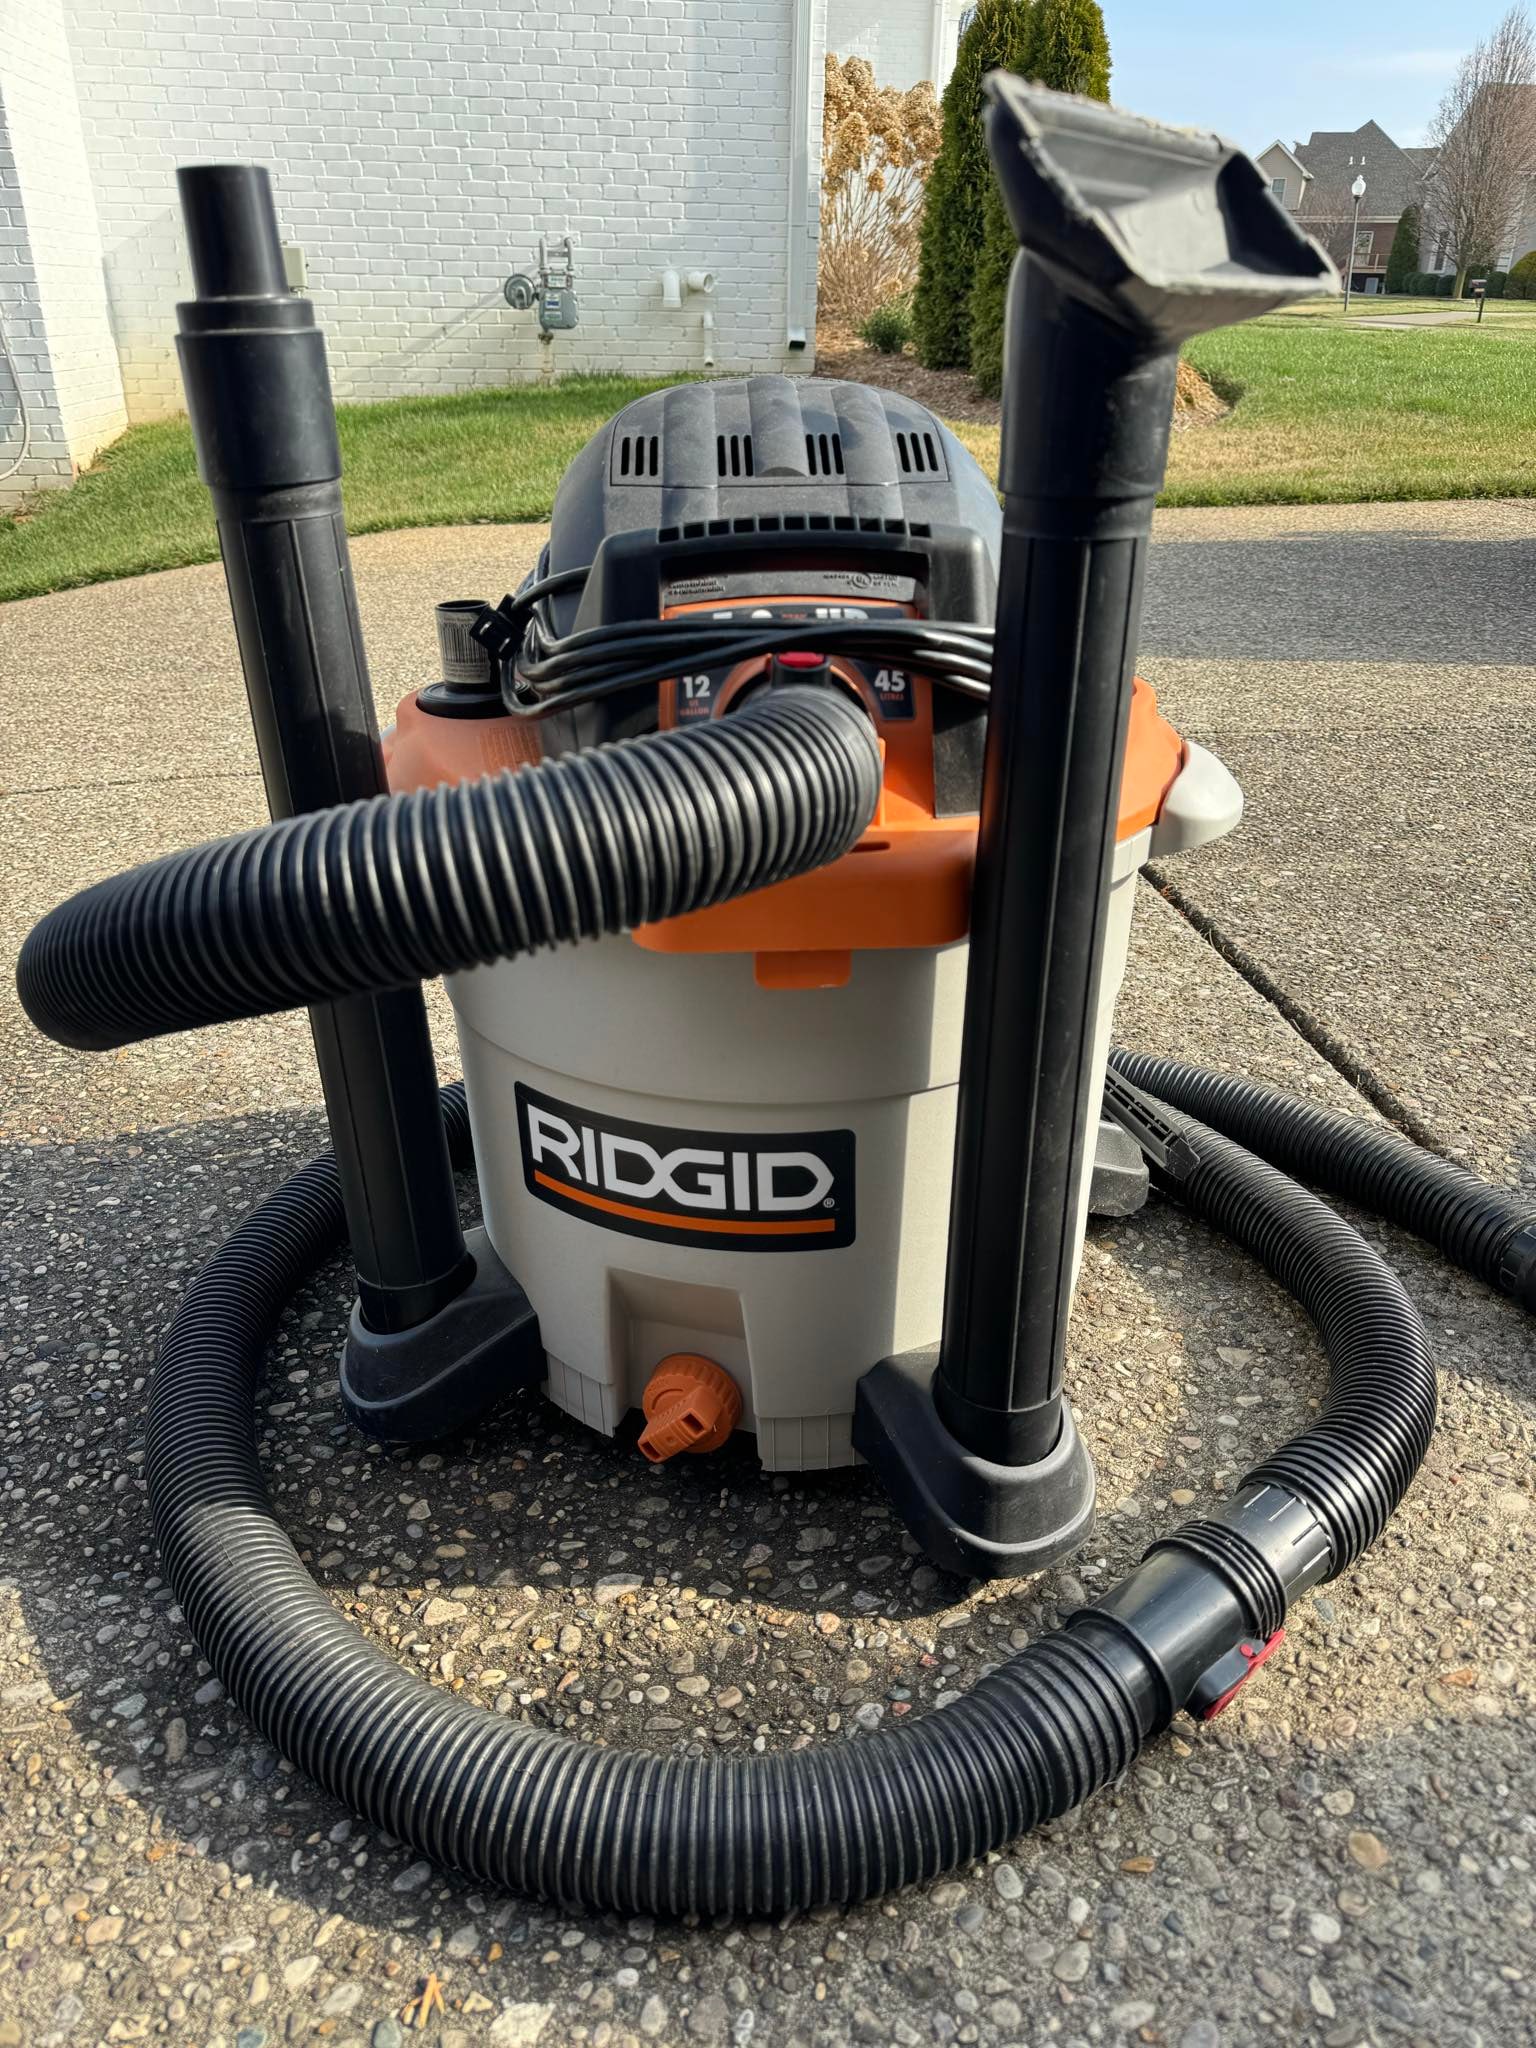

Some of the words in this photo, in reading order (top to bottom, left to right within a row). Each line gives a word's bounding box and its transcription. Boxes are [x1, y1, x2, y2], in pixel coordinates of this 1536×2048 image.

[682, 674, 710, 699] 12
[874, 669, 905, 692] 45
[527, 1103, 835, 1212] RIDGID
